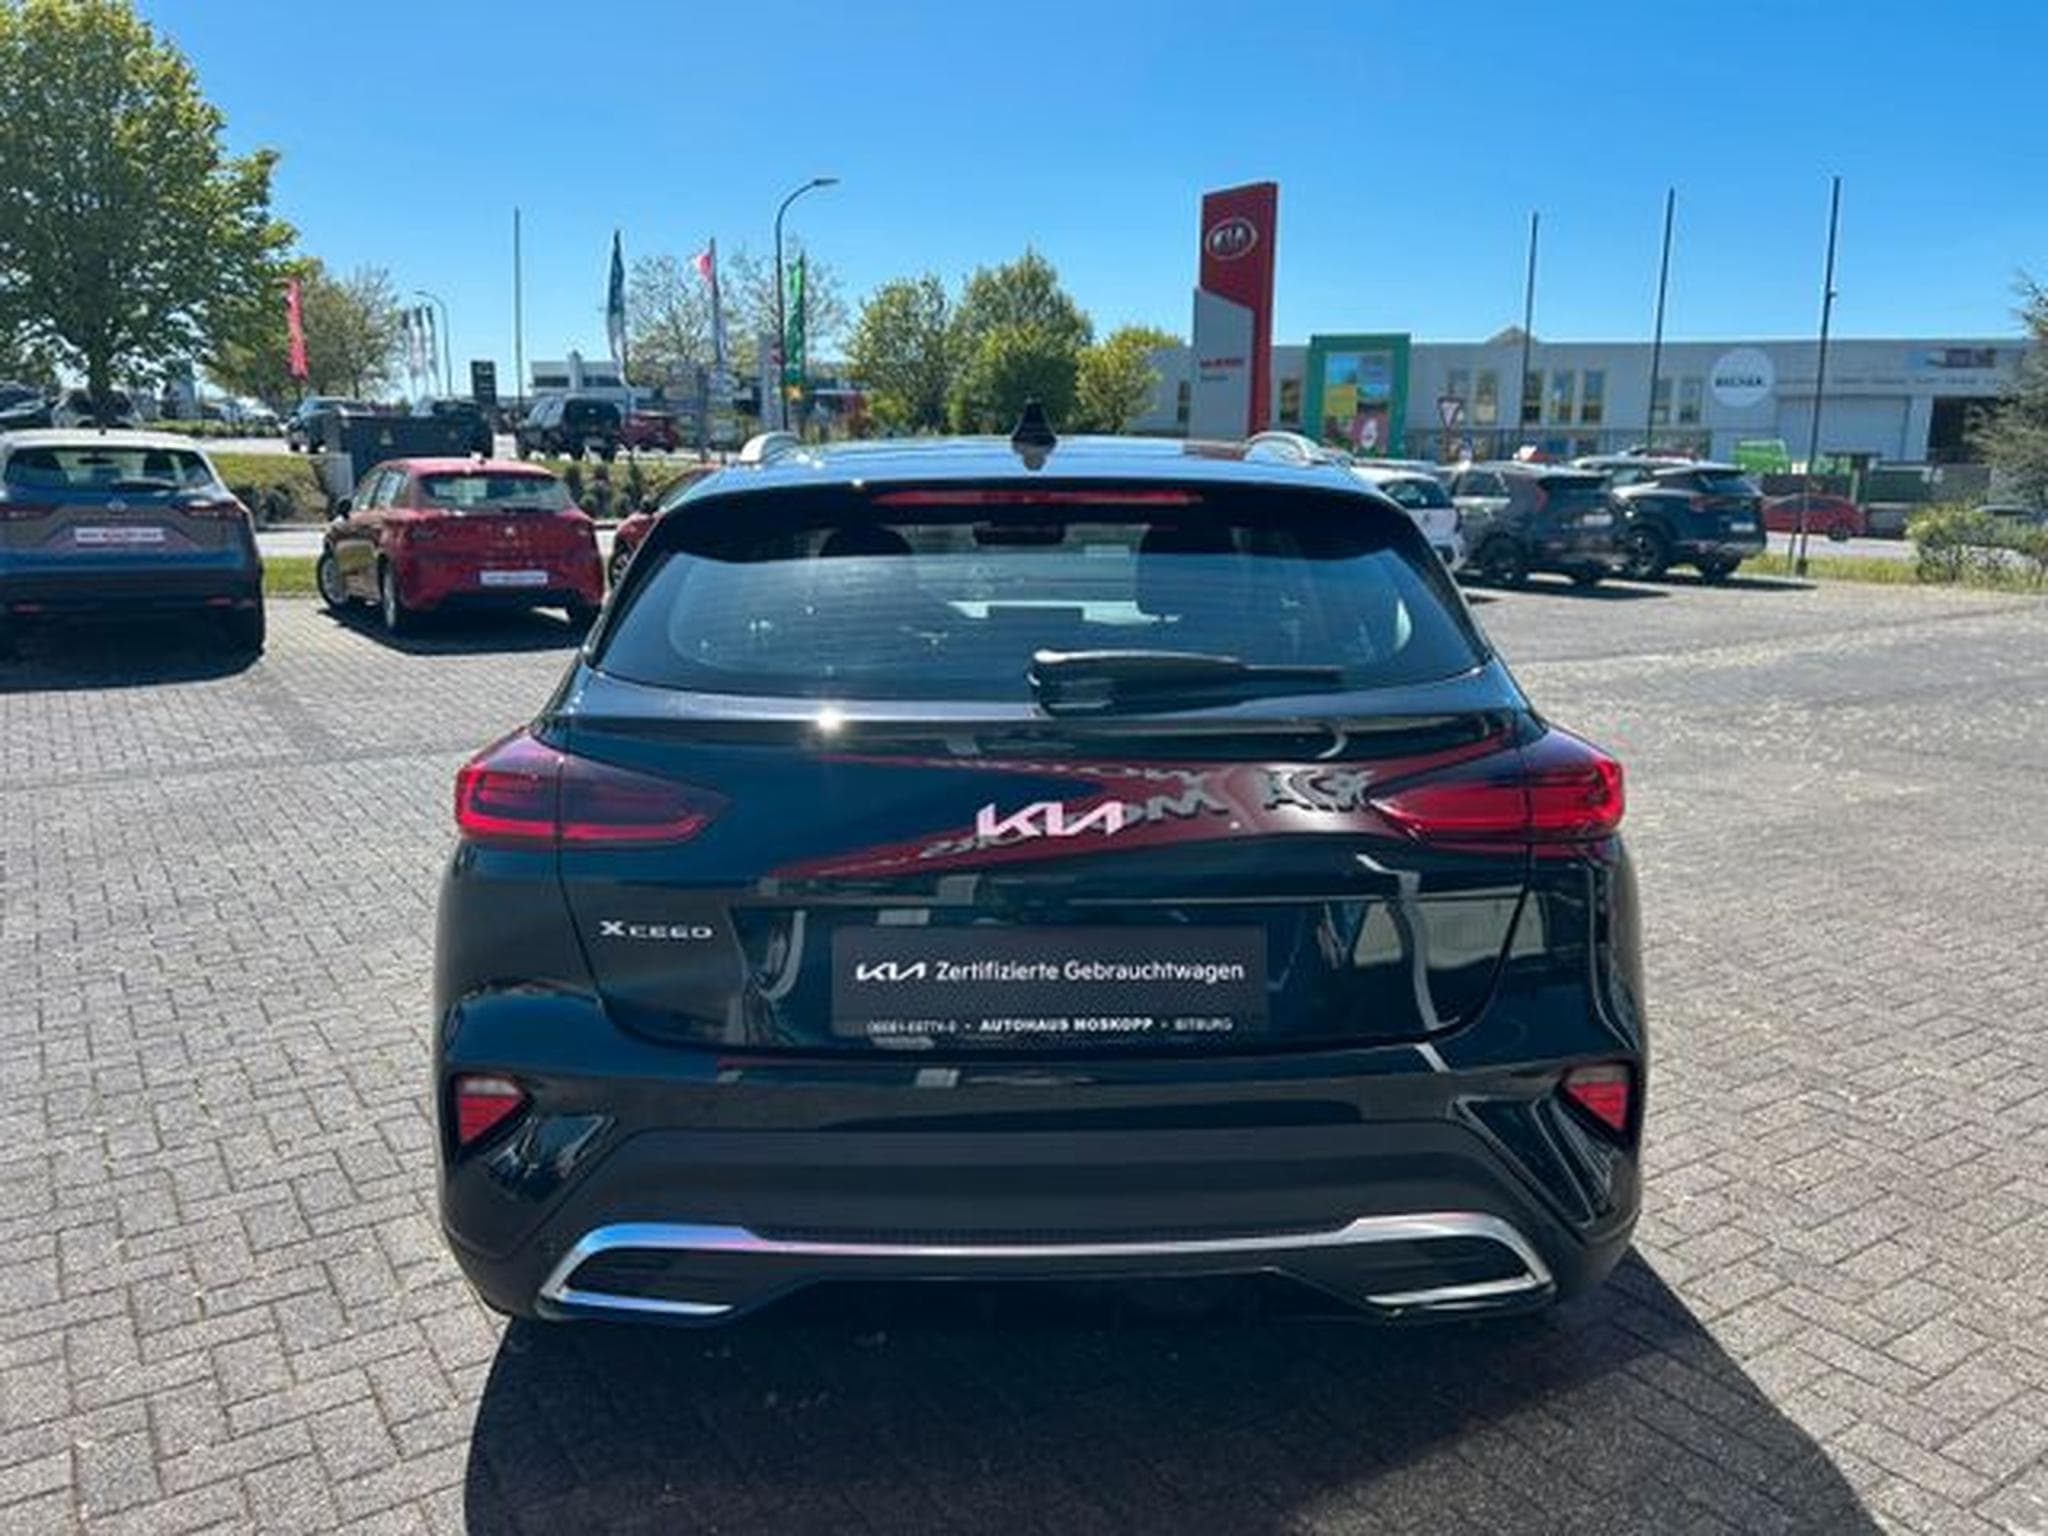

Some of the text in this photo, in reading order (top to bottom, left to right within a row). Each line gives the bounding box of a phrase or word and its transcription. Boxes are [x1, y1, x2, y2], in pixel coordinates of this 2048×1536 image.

[977, 801, 1124, 837] KIA
[856, 960, 1245, 985] KIA Zertifizierte Gebrauchtwagen
[979, 1017, 1070, 1033] AUTOHAUS
